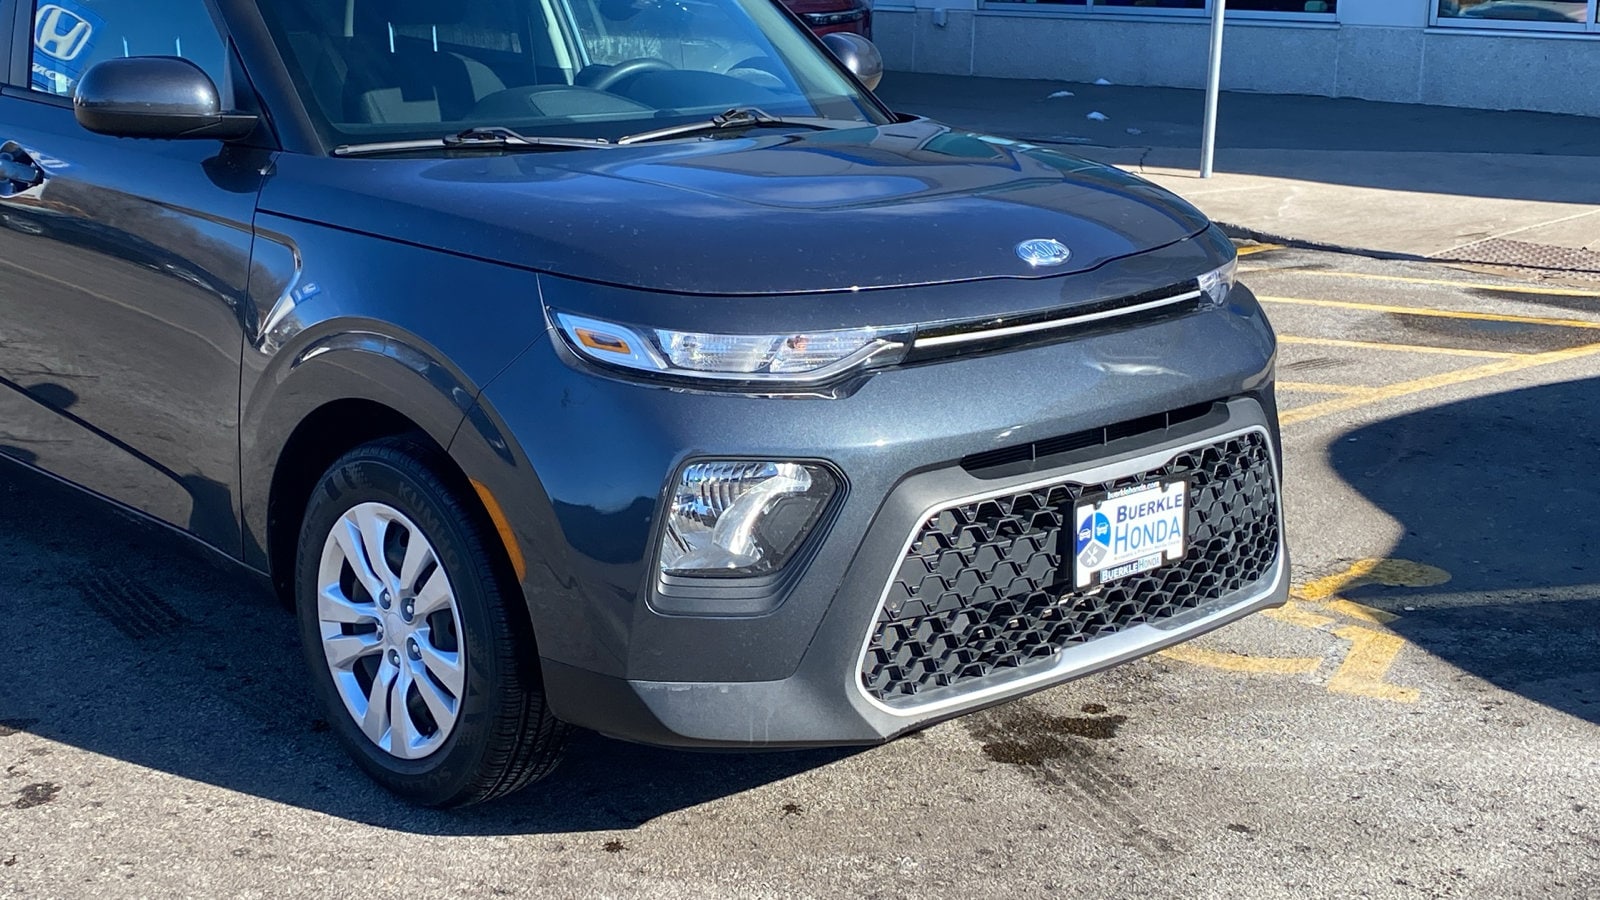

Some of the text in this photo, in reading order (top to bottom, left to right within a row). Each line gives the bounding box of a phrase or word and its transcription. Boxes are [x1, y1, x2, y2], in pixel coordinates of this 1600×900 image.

[1020, 241, 1069, 261] KIA
[1117, 494, 1183, 523] BUERKLE
[1114, 516, 1181, 554] HONDA
